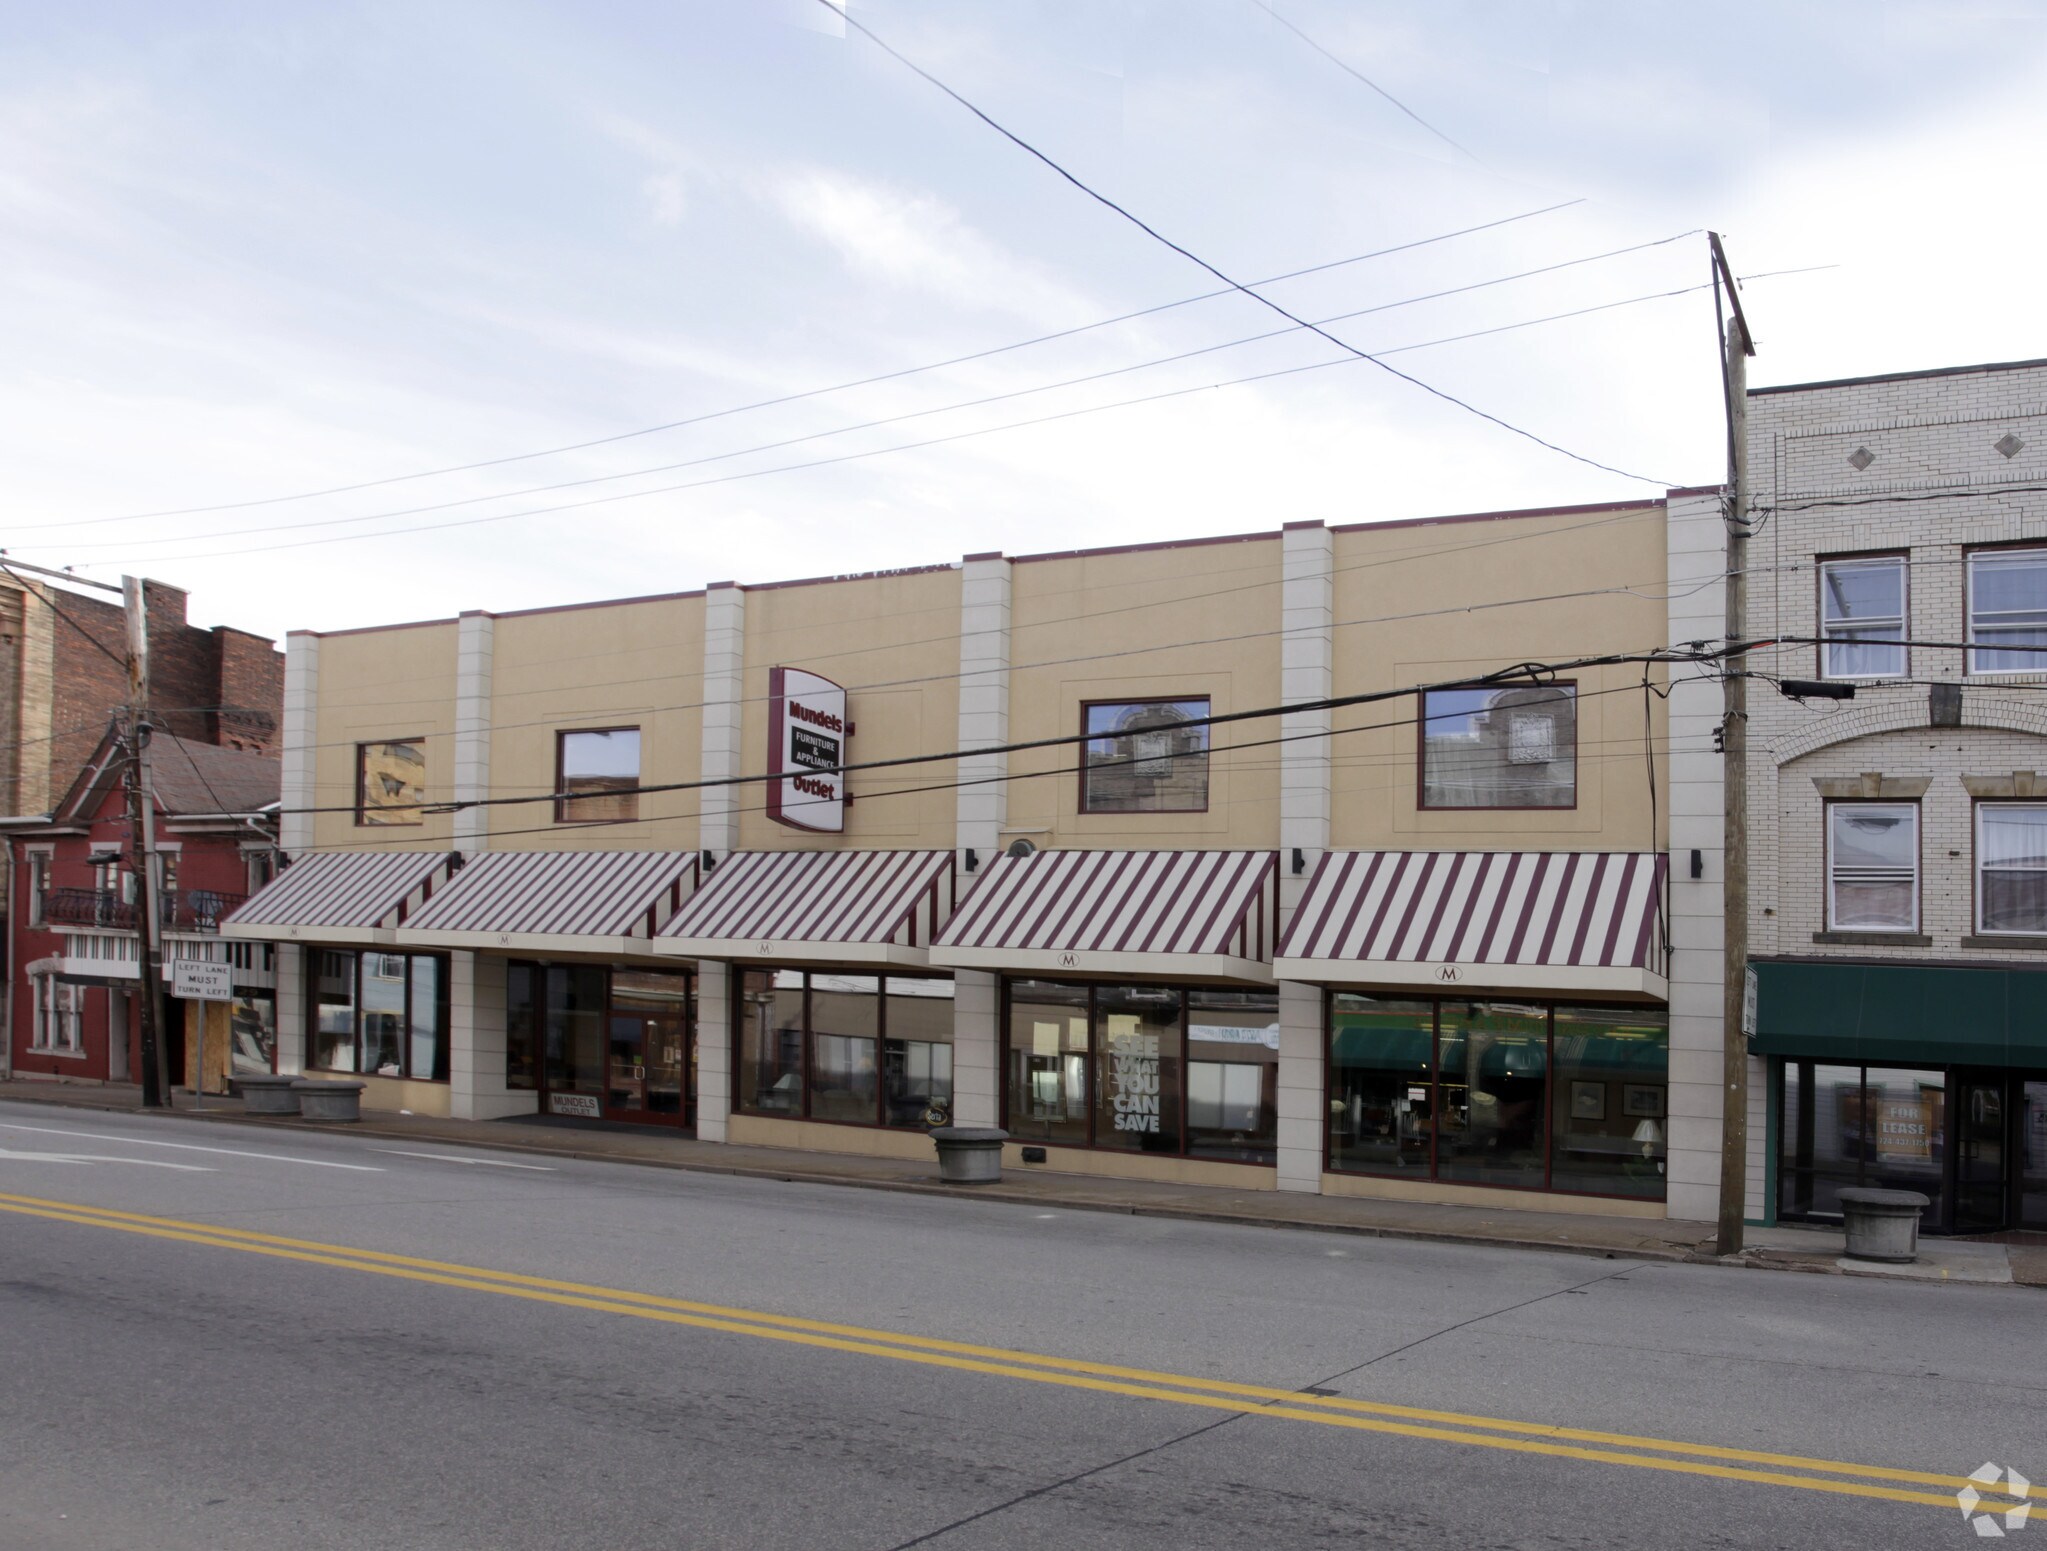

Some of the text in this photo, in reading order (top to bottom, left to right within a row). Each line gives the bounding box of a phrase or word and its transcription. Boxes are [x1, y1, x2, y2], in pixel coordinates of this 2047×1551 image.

[789, 700, 842, 733] Mundels
[796, 731, 835, 752] FURNITURE
[812, 746, 819, 756] &
[796, 751, 835, 769] APPLIANCE
[793, 775, 835, 801] Outlet
[178, 963, 228, 975] LEFT LANE
[1441, 967, 1456, 980] M
[188, 975, 218, 985] MUST
[177, 985, 201, 994] TURN
[1114, 1034, 1160, 1059] SEE
[1114, 1057, 1160, 1074] WHAT
[1115, 1072, 1160, 1095] YOU
[553, 1096, 596, 1110] MUNDELS
[1114, 1093, 1160, 1115] CAN
[561, 1106, 591, 1116] OUTLET
[1890, 1107, 1919, 1119] FOR
[1114, 1113, 1160, 1133] SAVE
[1882, 1122, 1926, 1135] LEASE
